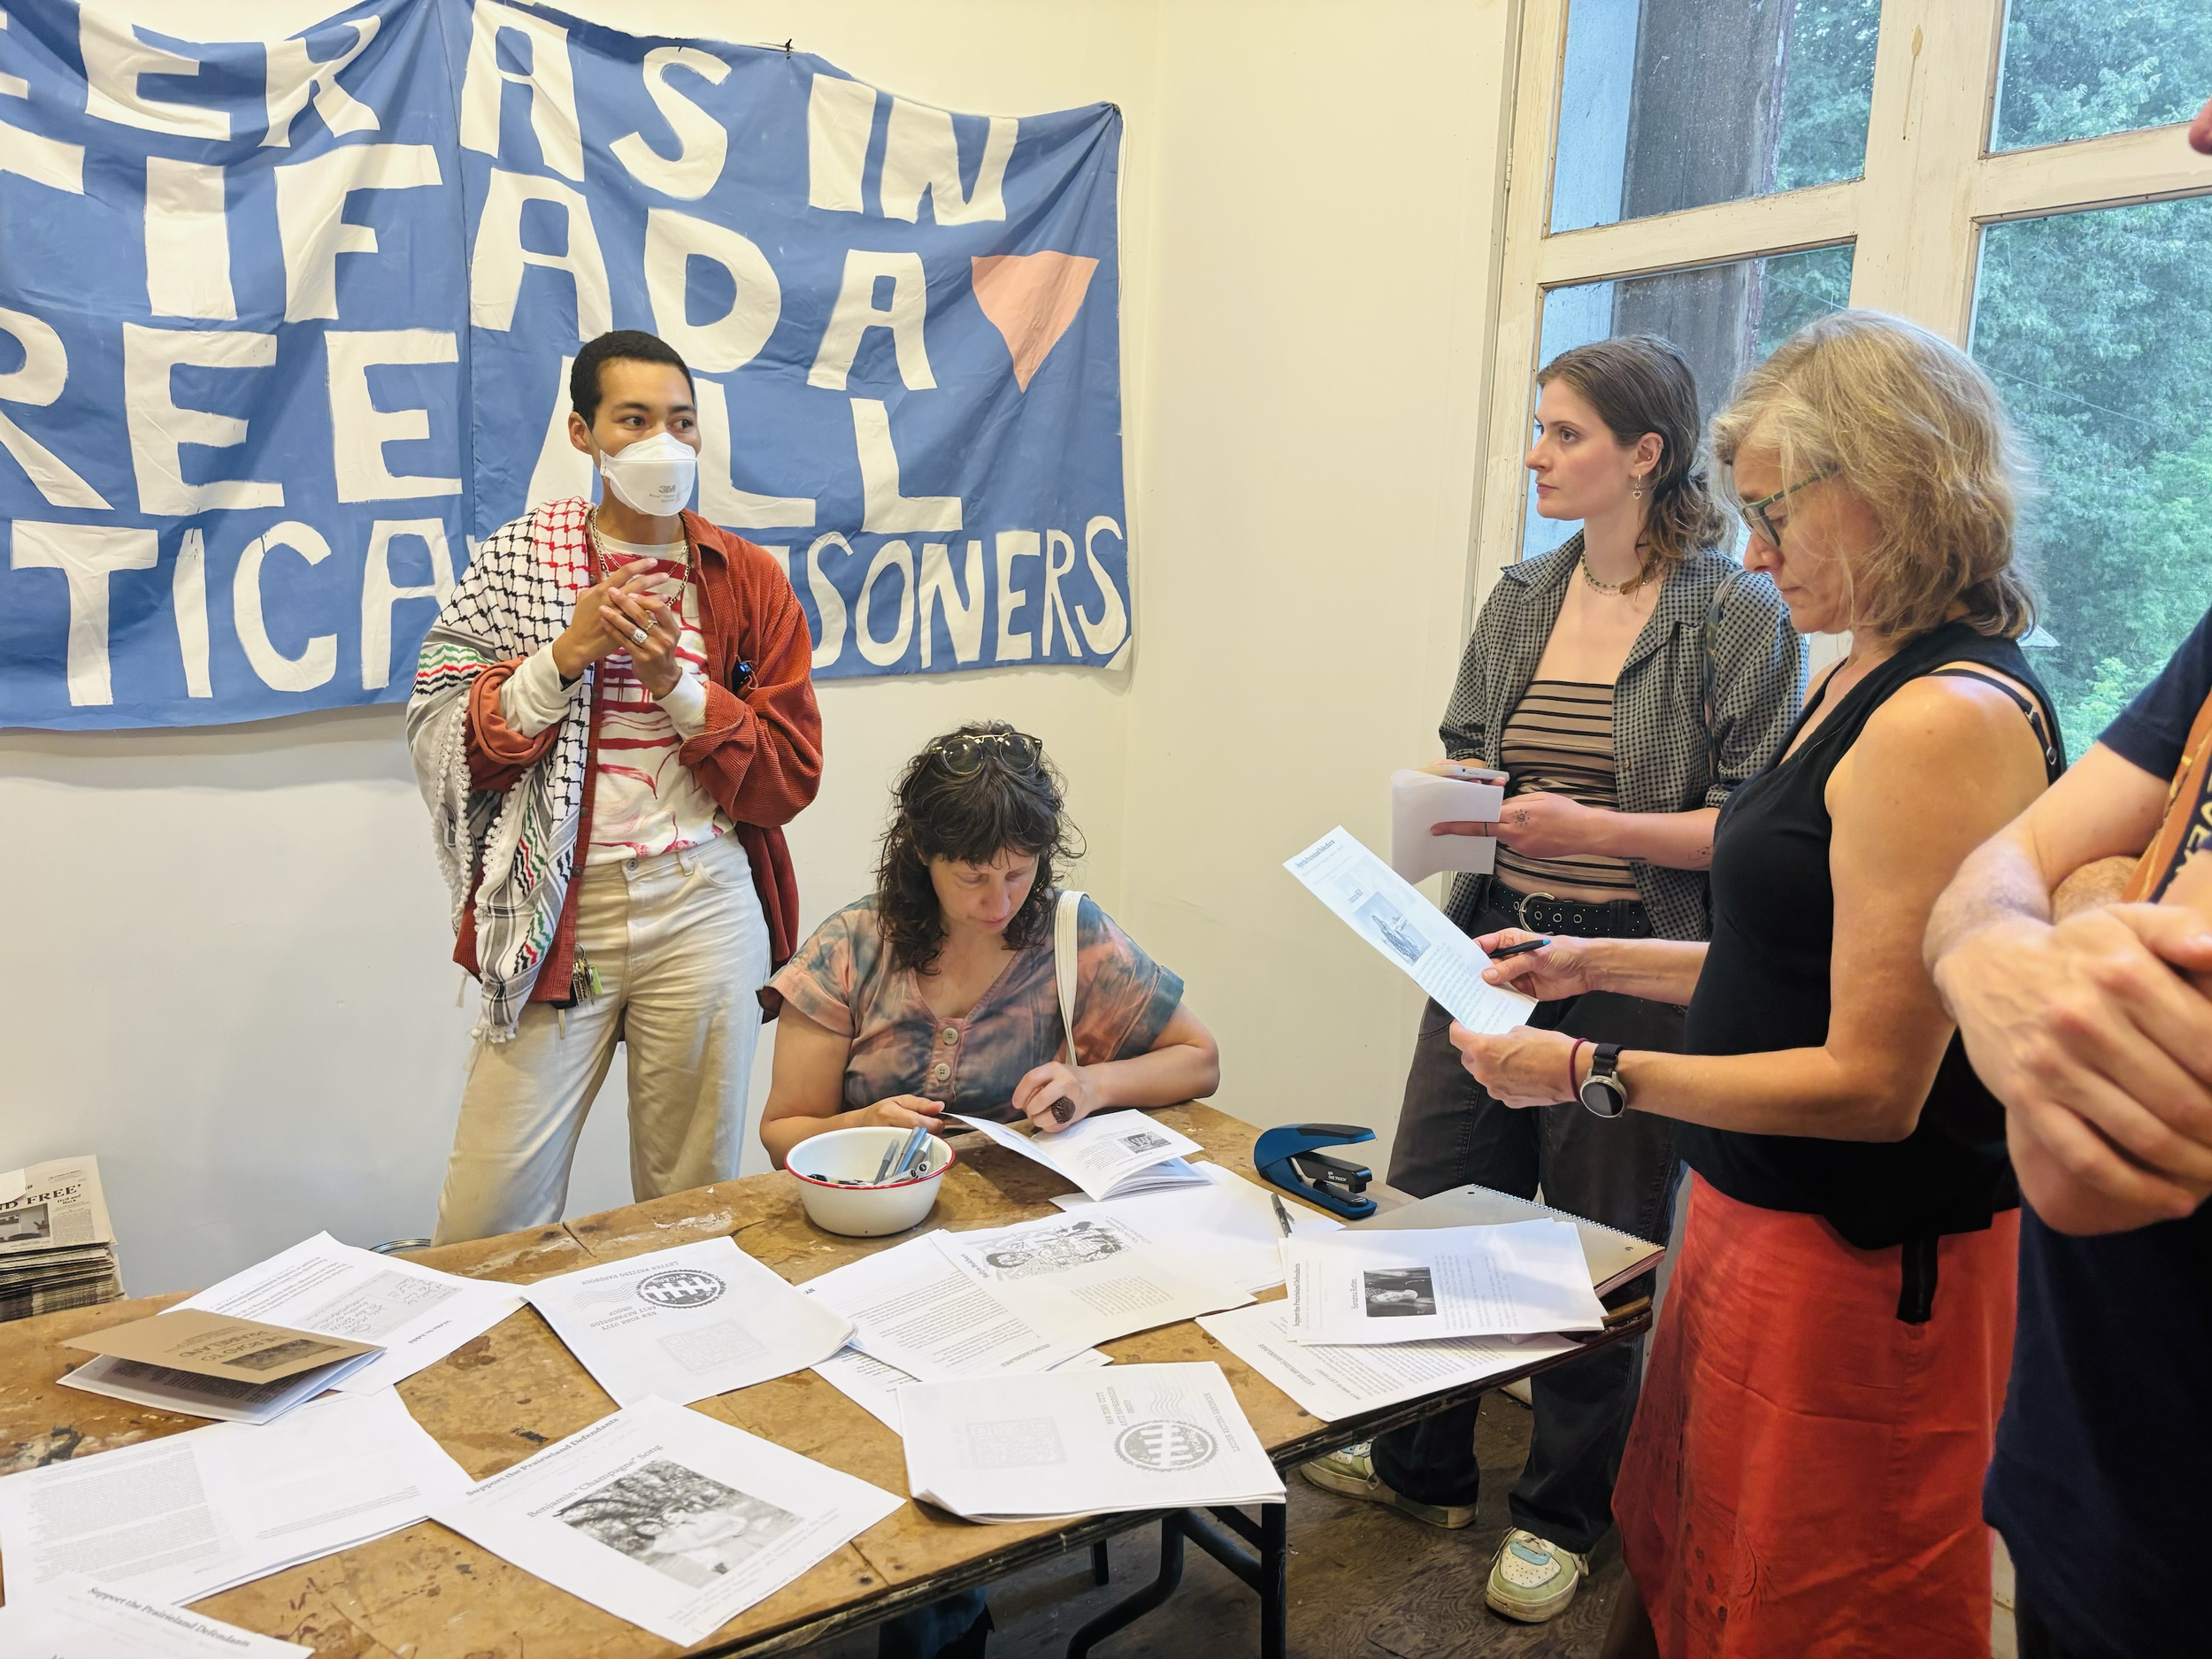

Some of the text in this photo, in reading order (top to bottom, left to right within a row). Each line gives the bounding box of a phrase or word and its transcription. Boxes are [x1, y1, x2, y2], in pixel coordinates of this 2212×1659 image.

[0, 0, 1018, 227] ER AS IN
[659, 484, 676, 493] 3M
[12, 515, 1132, 706] TICA SONERS
[581, 1260, 680, 1286] LETTER WRITING HANDBOOK
[589, 1310, 638, 1328] REPRESSION
[608, 1305, 633, 1316] GROUP
[621, 1316, 641, 1325] YORK
[602, 1322, 620, 1331] CITY
[465, 1417, 619, 1497] Support the Prairieland Defendants
[526, 1490, 577, 1519] Benjamin
[637, 1444, 664, 1460] Song
[88, 1586, 251, 1647] Support the Prairieland Defendants
